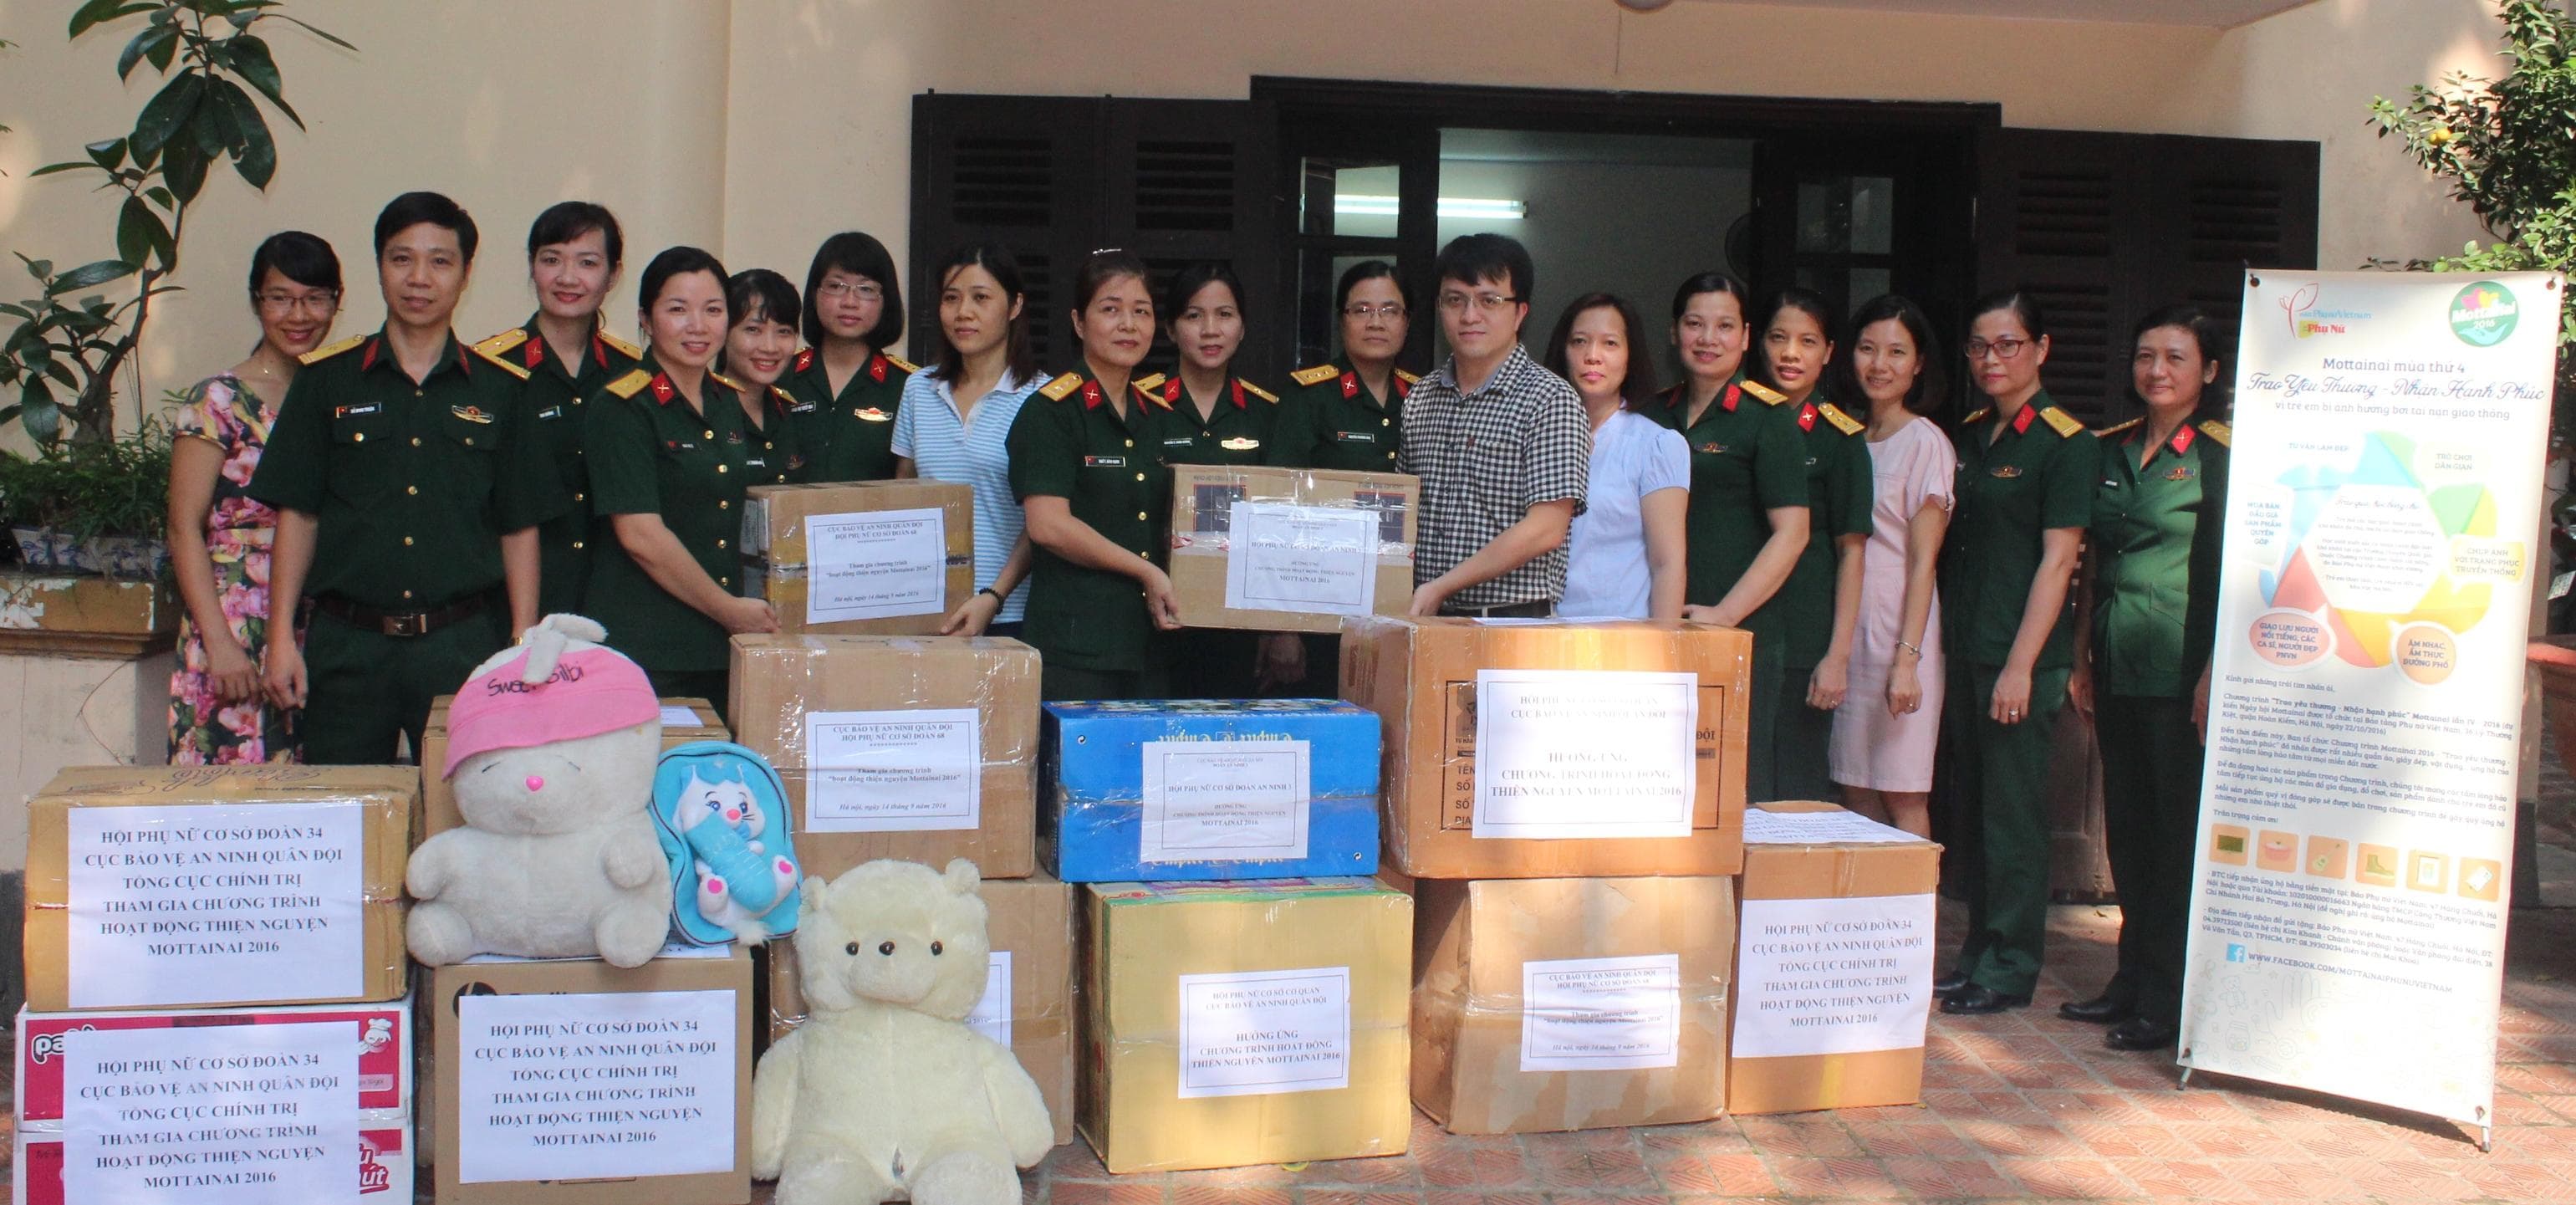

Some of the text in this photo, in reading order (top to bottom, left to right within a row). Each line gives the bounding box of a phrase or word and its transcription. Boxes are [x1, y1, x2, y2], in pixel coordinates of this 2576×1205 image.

[2473, 319, 2496, 329] 2016
[2247, 373, 2283, 391] Trao
[101, 823, 324, 846] HỘI PHỤ NỮ CƠ SỞ ĐOÀN 34
[85, 845, 343, 869] CỤC BẢO VỆ AN NINH QUÂN ĐỘI
[123, 871, 302, 891] TỔNG CỤC CHÍNH TRỊ
[103, 891, 321, 912] THAM GIA CHƯƠNG TRÌNH
[100, 912, 328, 937] HOẠT ĐỘNG THIỆN NGUYỆN
[147, 940, 280, 956] MOTTAINAI 2016
[490, 1017, 699, 1039] HỘI PHỤ NỮ CƠ SỞ ĐOÀN 34
[1790, 1012, 1878, 1027] MOTTAINAI 2016
[475, 1037, 717, 1062] CỤC BẢO VỆ AN NINH QUÂN ĐỘI
[97, 1051, 320, 1077] HỘI PHỤ NỮ CƠ SỞ ĐOÀN 34
[532, 1130, 656, 1146] MOTTAINAI 2016
[144, 1171, 277, 1188] MOTTAINAI 2016
